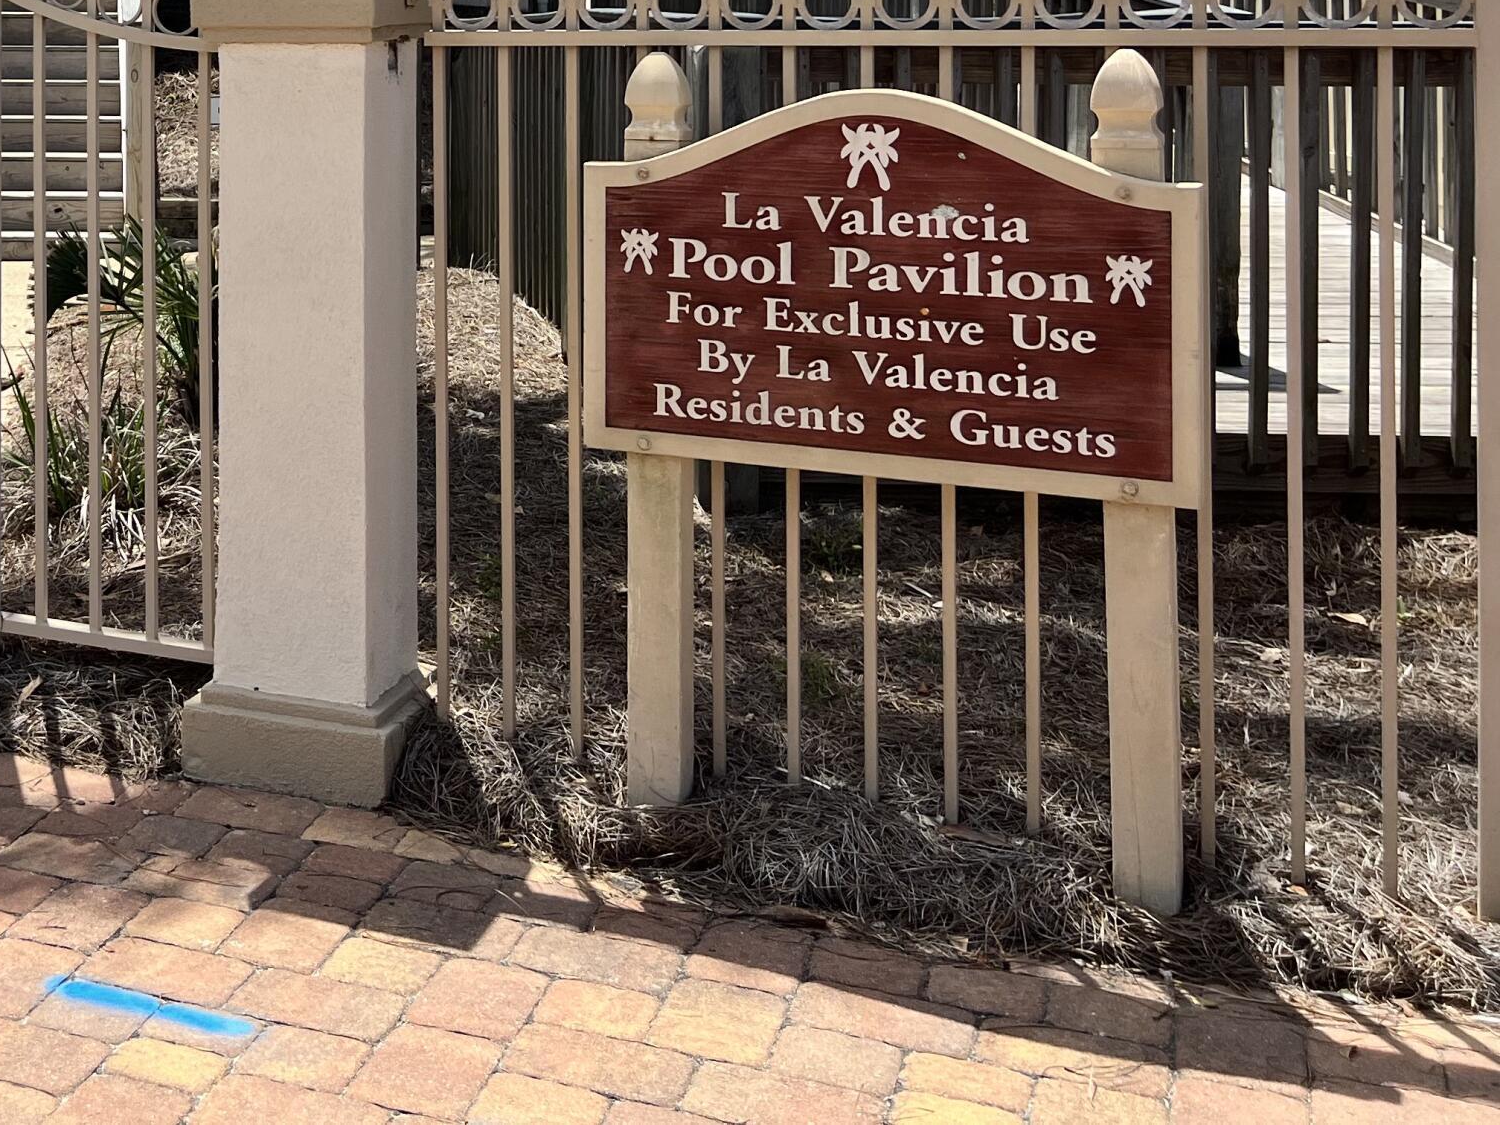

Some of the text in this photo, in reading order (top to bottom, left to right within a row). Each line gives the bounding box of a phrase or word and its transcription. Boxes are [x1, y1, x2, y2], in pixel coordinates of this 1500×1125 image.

[721, 191, 1029, 244] La Valencia
[668, 237, 1094, 305] Pool Pavilion
[665, 291, 1098, 355] For Exclusive Use
[697, 339, 1060, 402] By La Valencia
[653, 382, 1117, 459] Residents & Guests
